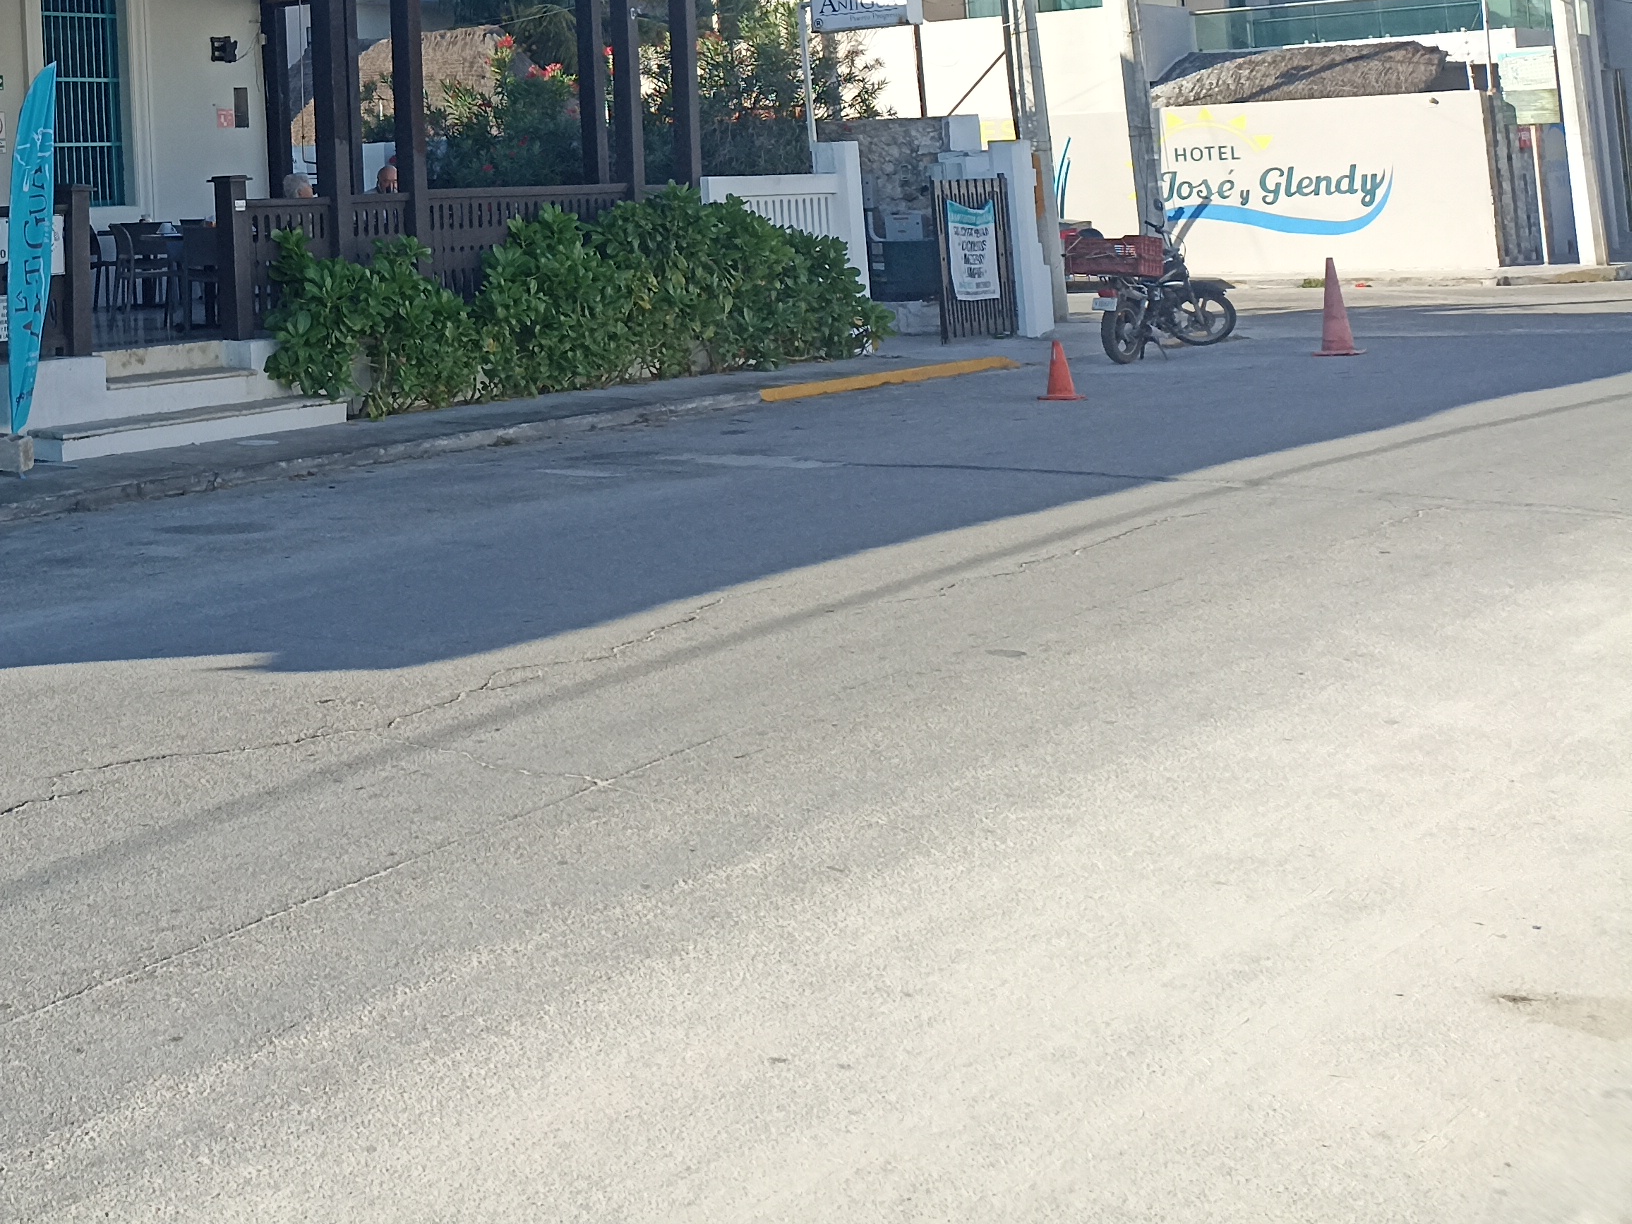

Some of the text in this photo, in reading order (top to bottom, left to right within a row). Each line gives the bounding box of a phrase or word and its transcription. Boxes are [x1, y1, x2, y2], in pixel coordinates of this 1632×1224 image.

[1174, 145, 1241, 162] HOTEL
[1161, 163, 1386, 207] José y Glendy
